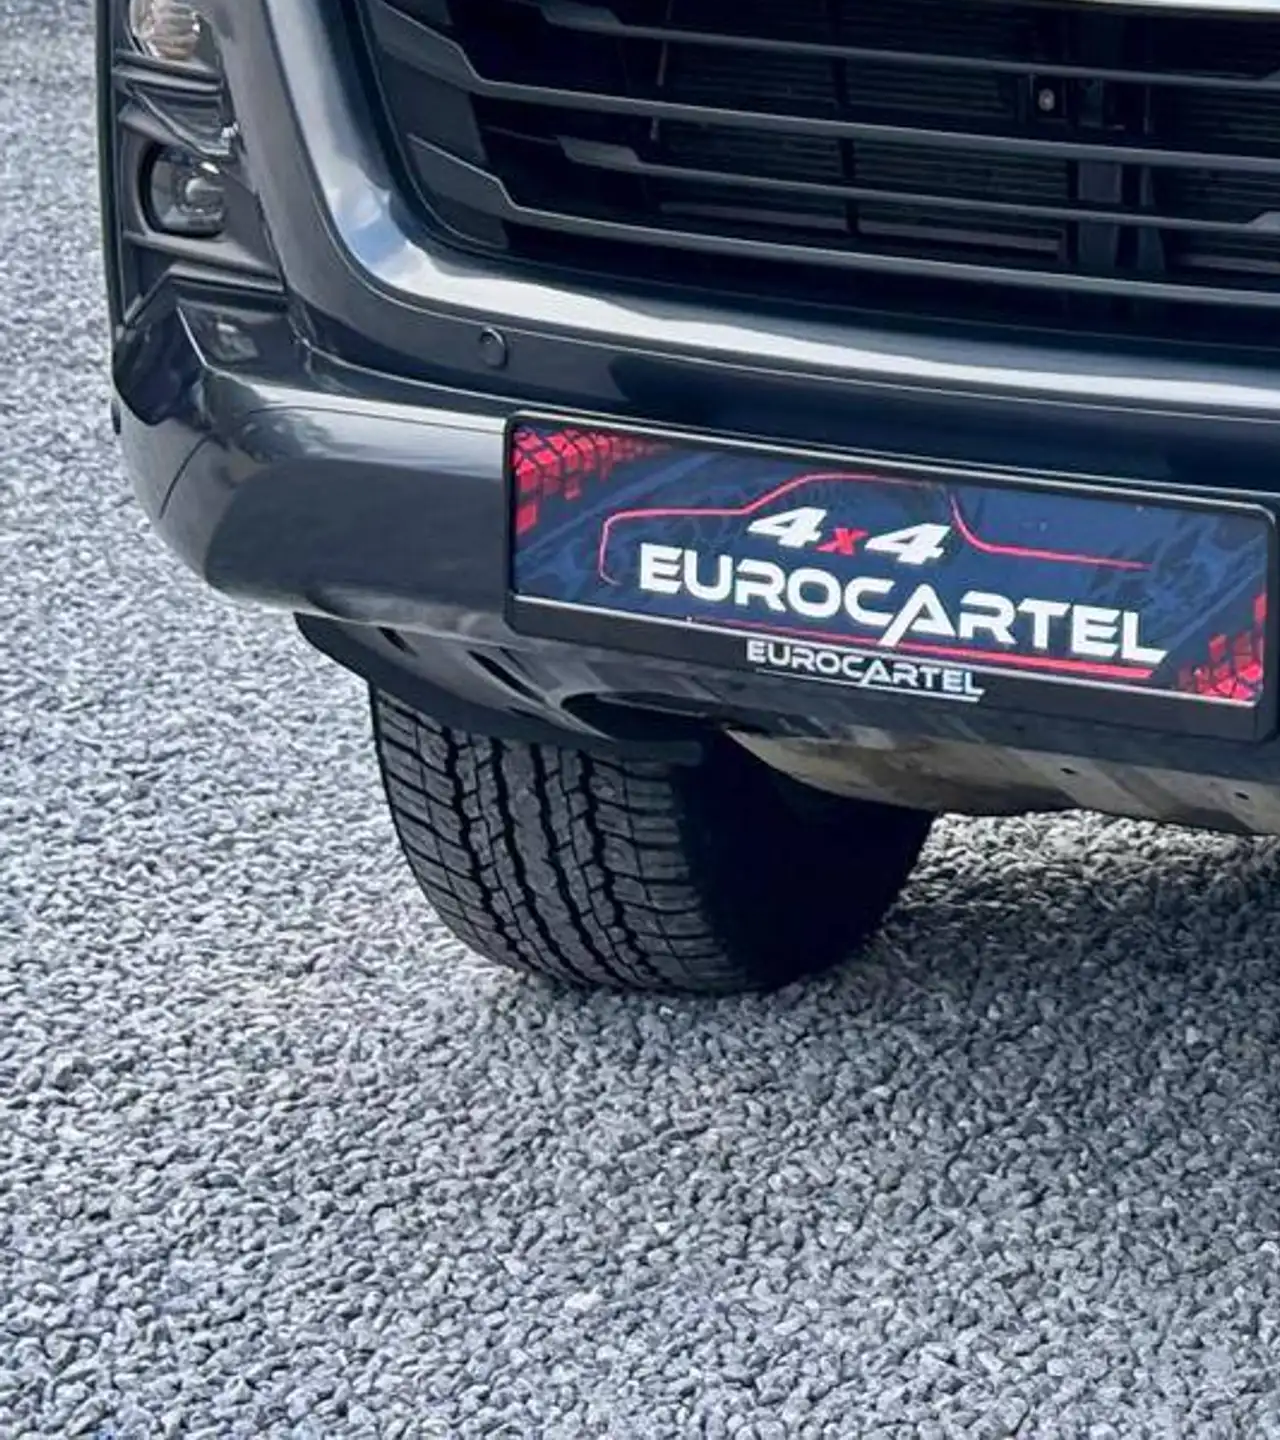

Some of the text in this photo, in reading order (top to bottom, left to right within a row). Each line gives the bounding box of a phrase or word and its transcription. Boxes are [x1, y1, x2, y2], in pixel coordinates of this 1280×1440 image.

[747, 506, 951, 563] 4x4
[638, 543, 1169, 664] EUROCARTEL
[745, 639, 985, 697] EUROCARTEL
